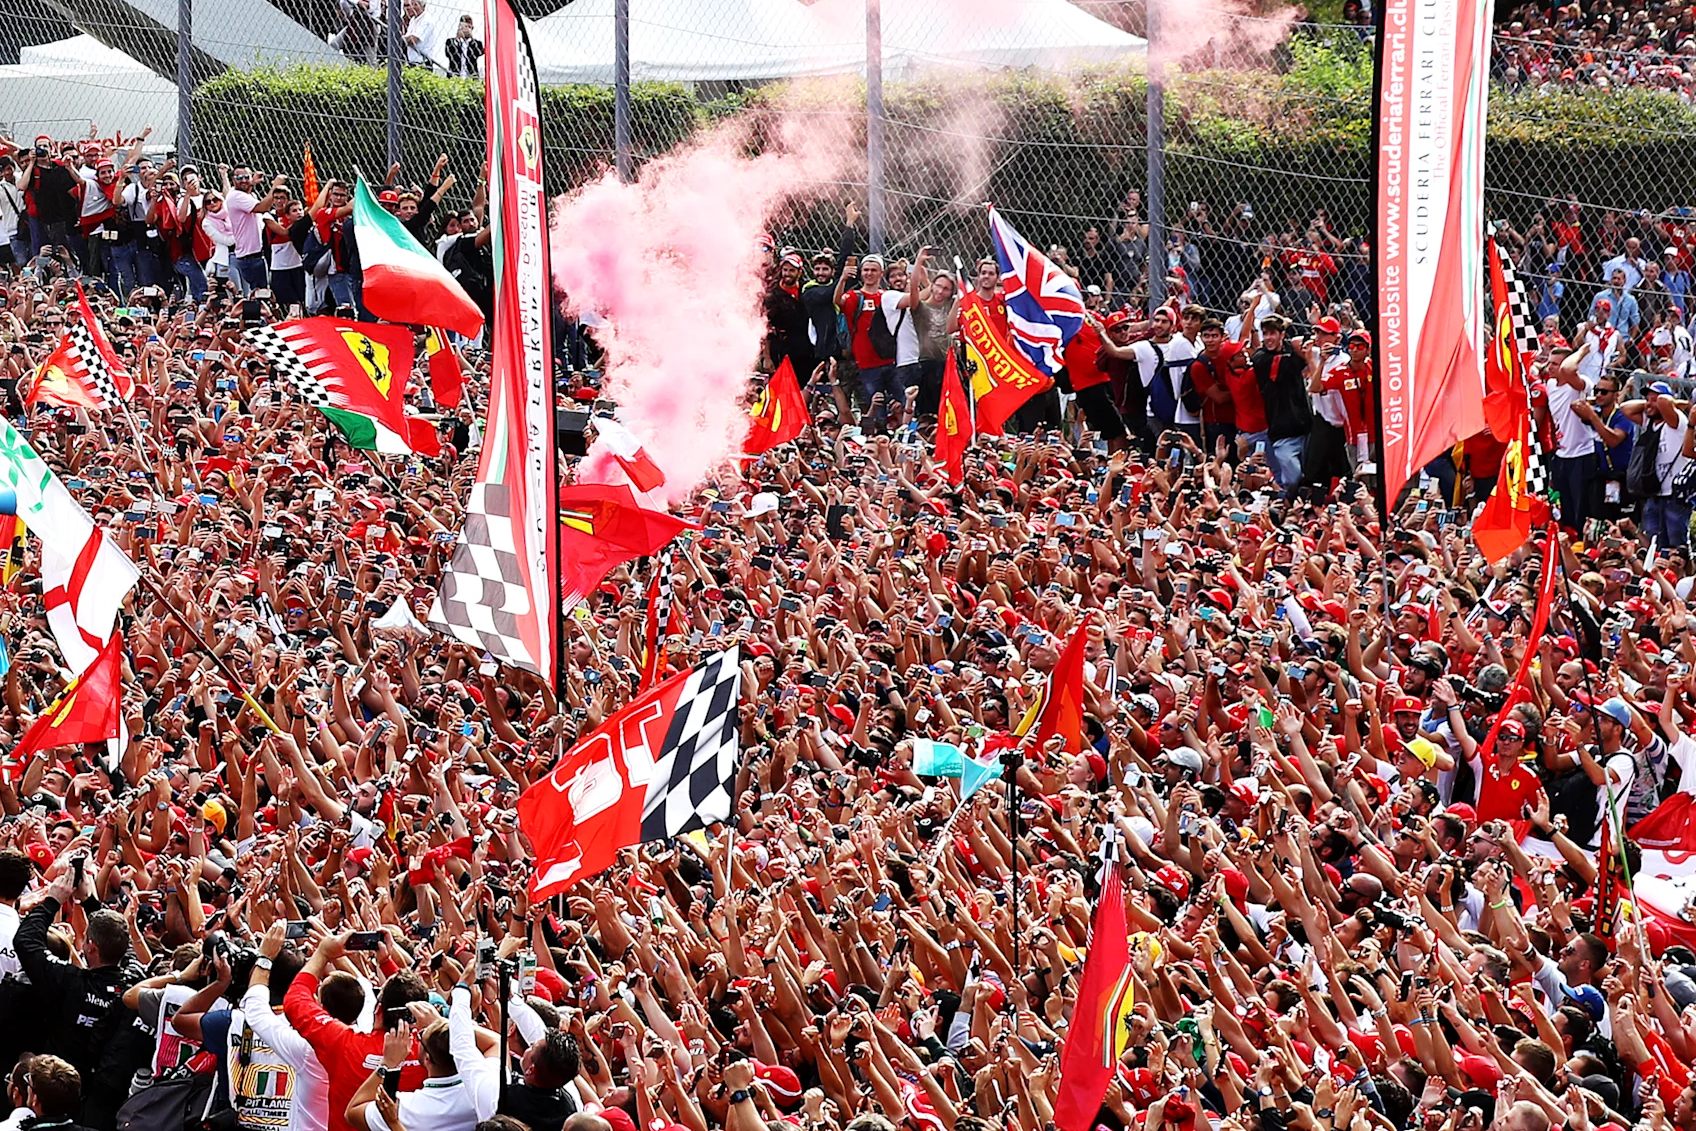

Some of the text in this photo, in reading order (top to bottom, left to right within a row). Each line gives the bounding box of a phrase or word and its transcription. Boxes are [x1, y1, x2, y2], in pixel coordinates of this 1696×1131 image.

[1419, 50, 1434, 140] FERRARI
[1415, 153, 1431, 265] SCUDERIA
[963, 302, 1040, 390] Ferrari
[1380, 265, 1400, 348] website
[1388, 352, 1403, 391] our
[1384, 395, 1403, 447] Visit
